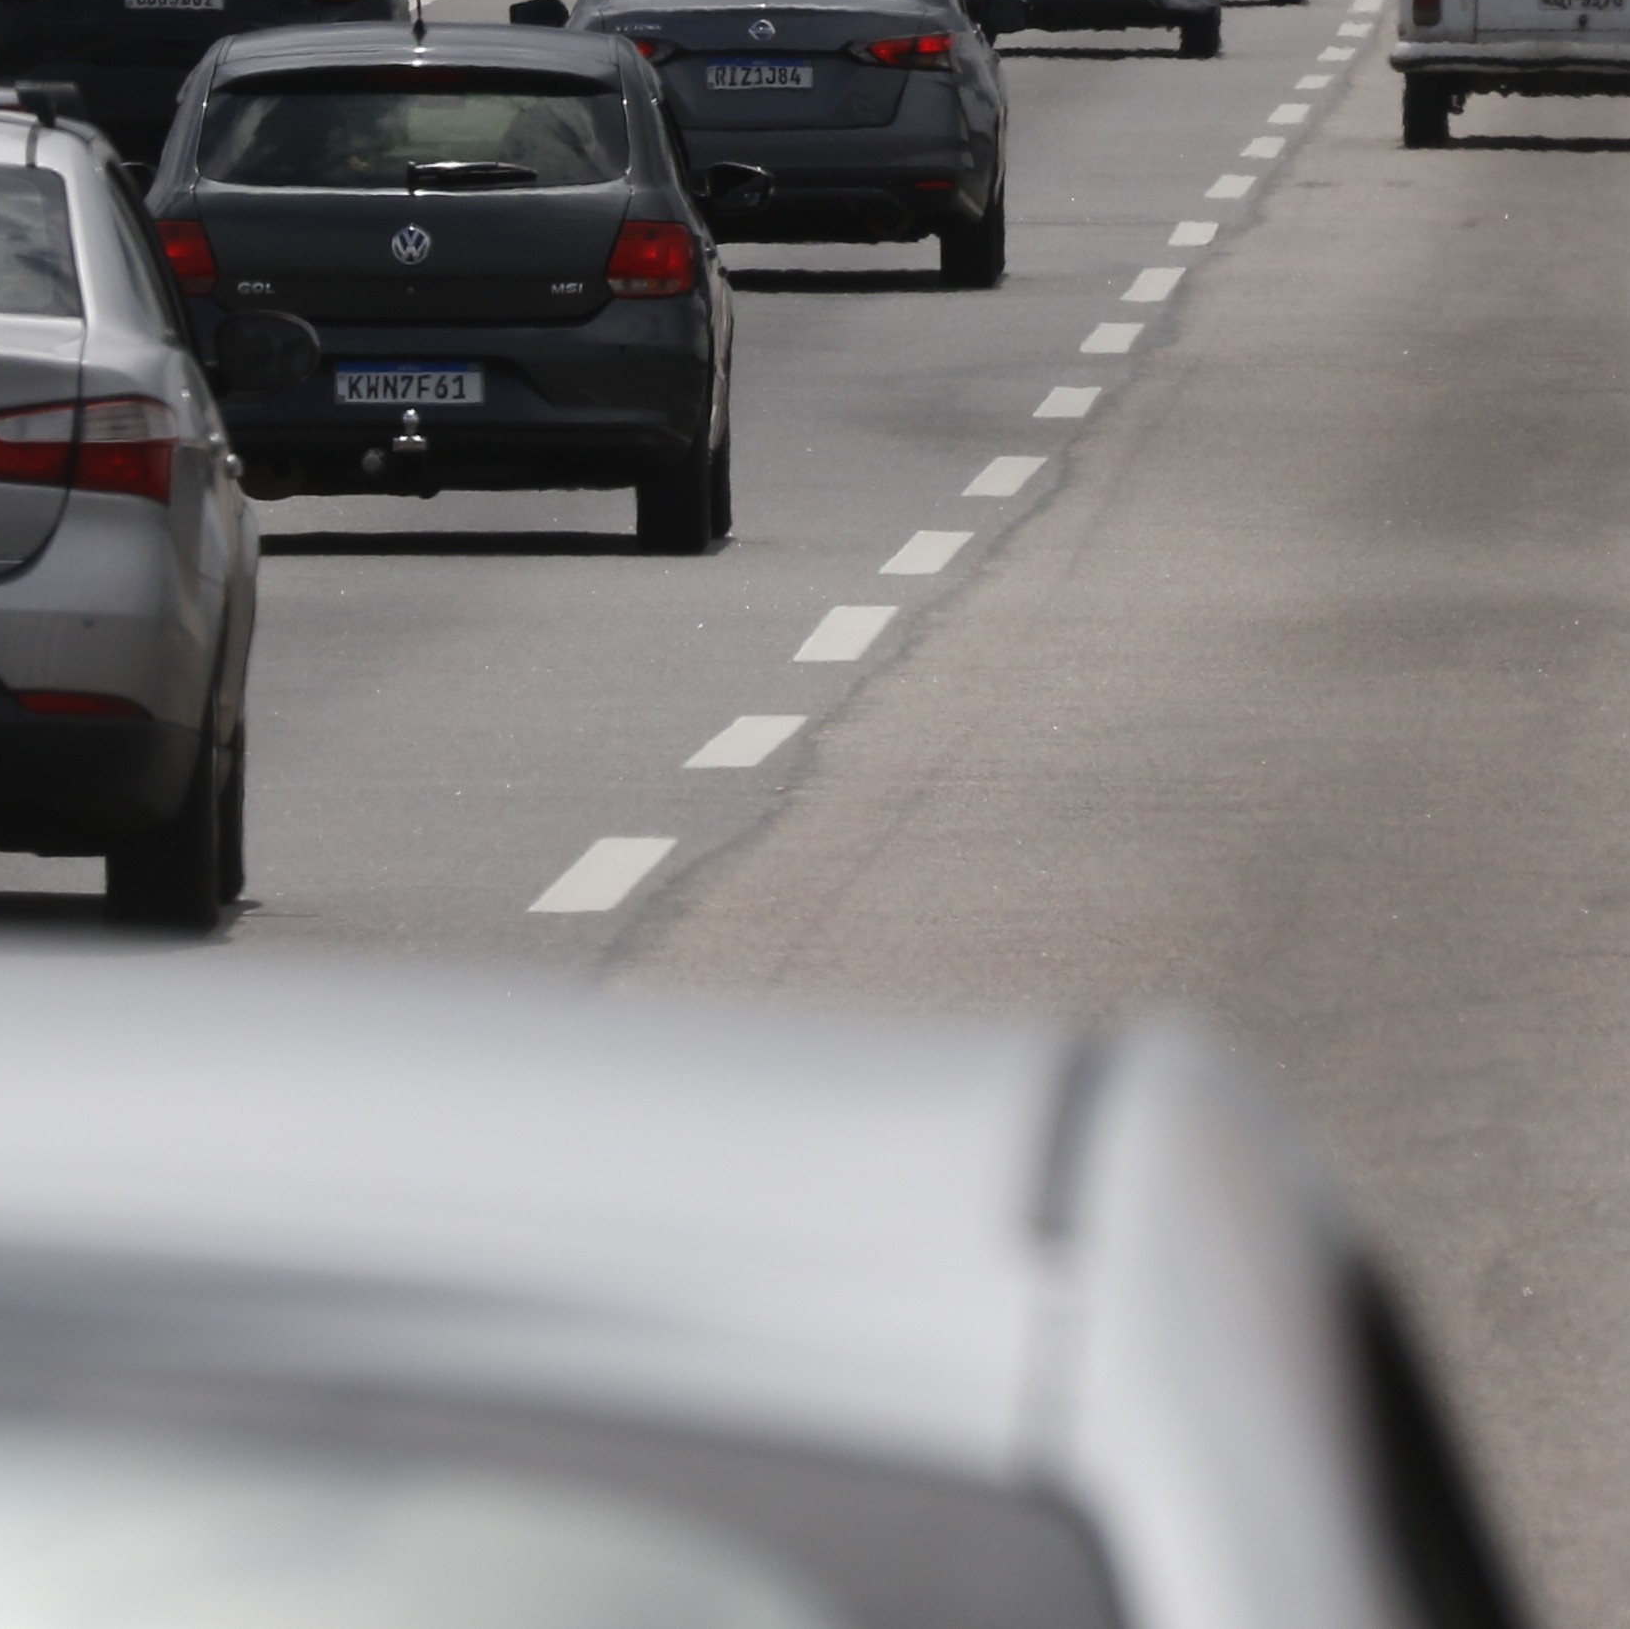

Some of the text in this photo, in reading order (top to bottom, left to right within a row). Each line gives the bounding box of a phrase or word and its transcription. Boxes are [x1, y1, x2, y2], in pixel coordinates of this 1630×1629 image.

[715, 67, 801, 87] RIZ1J84
[237, 281, 276, 294] GOL
[551, 282, 584, 294] MSI
[348, 374, 466, 399] KWN7F61
